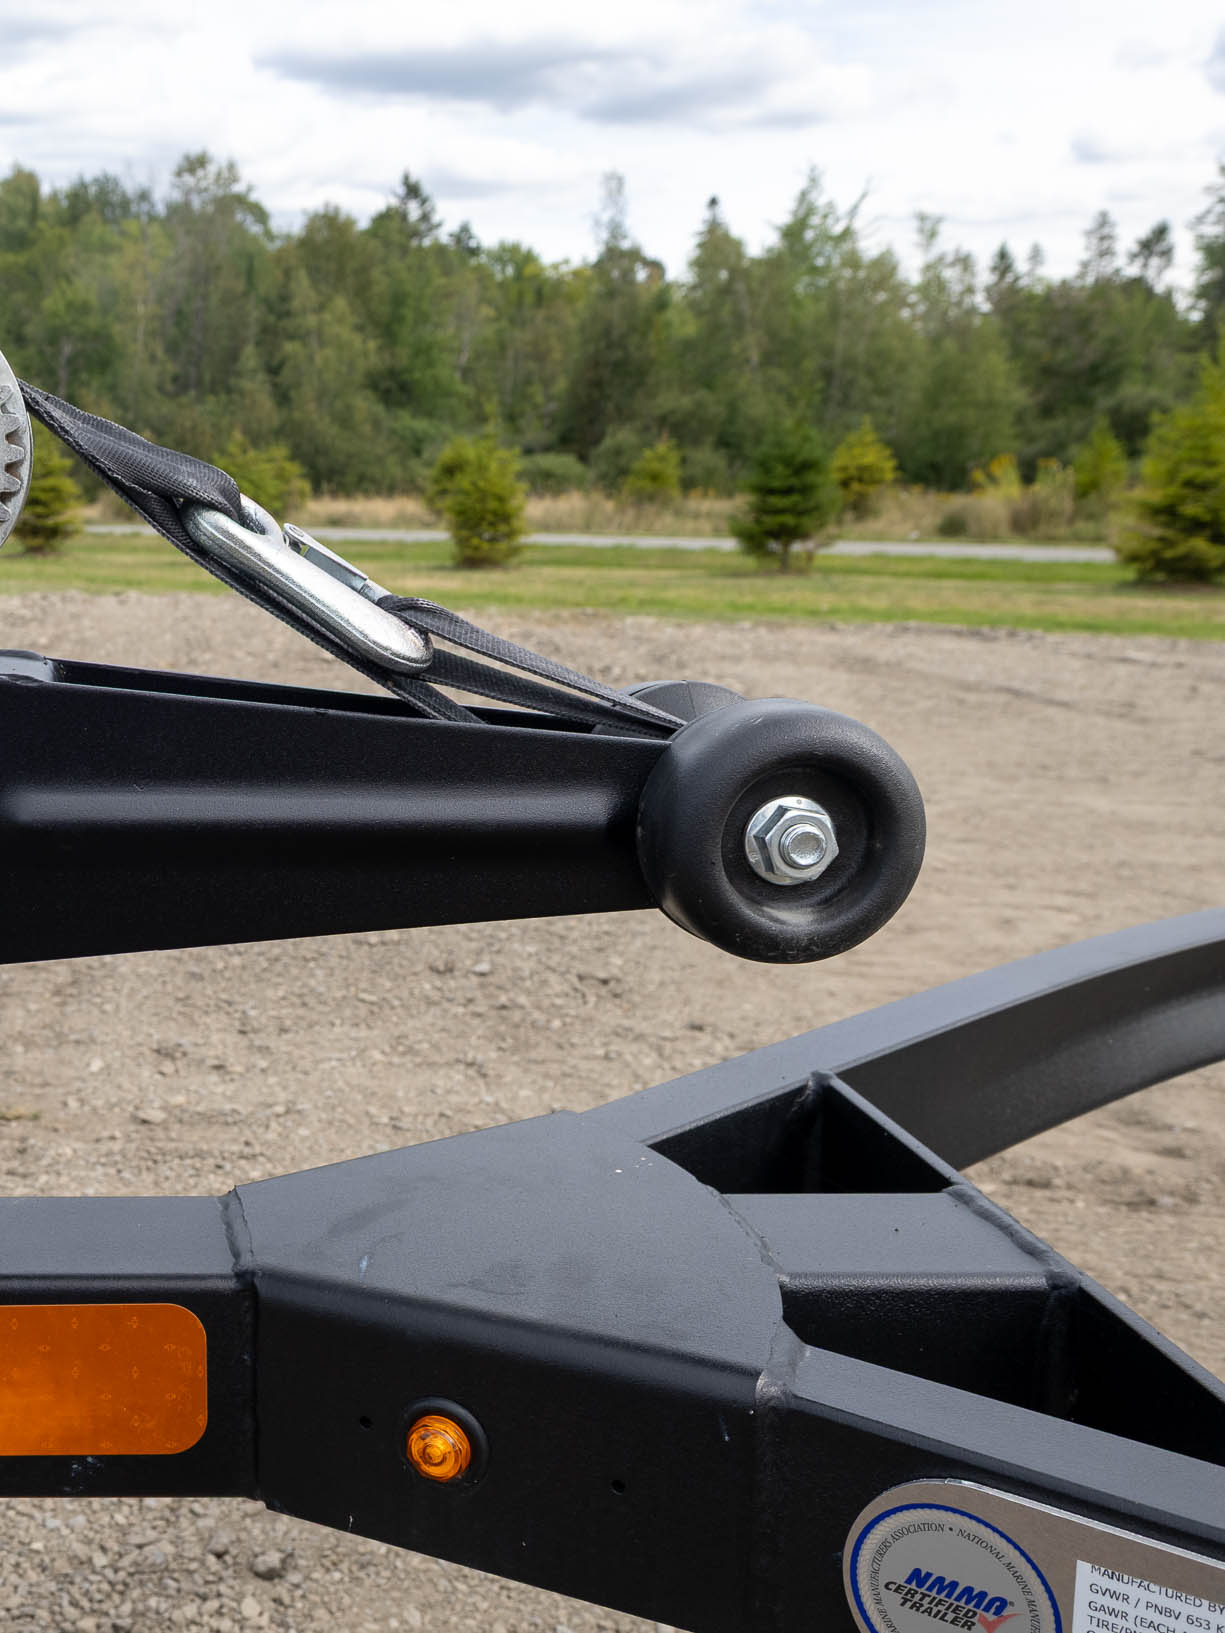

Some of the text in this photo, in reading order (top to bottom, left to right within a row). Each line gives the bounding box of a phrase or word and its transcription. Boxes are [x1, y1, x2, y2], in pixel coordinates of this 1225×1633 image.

[870, 1538, 893, 1605] MANUFACTURERS
[890, 1522, 945, 1543] ASSOCIATION
[957, 1528, 1005, 1562] NATIONAL
[1002, 1561, 1033, 1597] MARINE
[883, 1581, 978, 1620] CERTIFIED
[904, 1567, 1009, 1617] NMMA
[1089, 1583, 1130, 1605] GVWR
[1134, 1597, 1141, 1608] /
[1146, 1601, 1182, 1620] PNBV
[1186, 1614, 1211, 1631] 653
[1090, 1565, 1203, 1608] MANUFACTURED
[899, 1596, 977, 1632] TRAILER
[1088, 1600, 1175, 1633] GAWR (EACH
